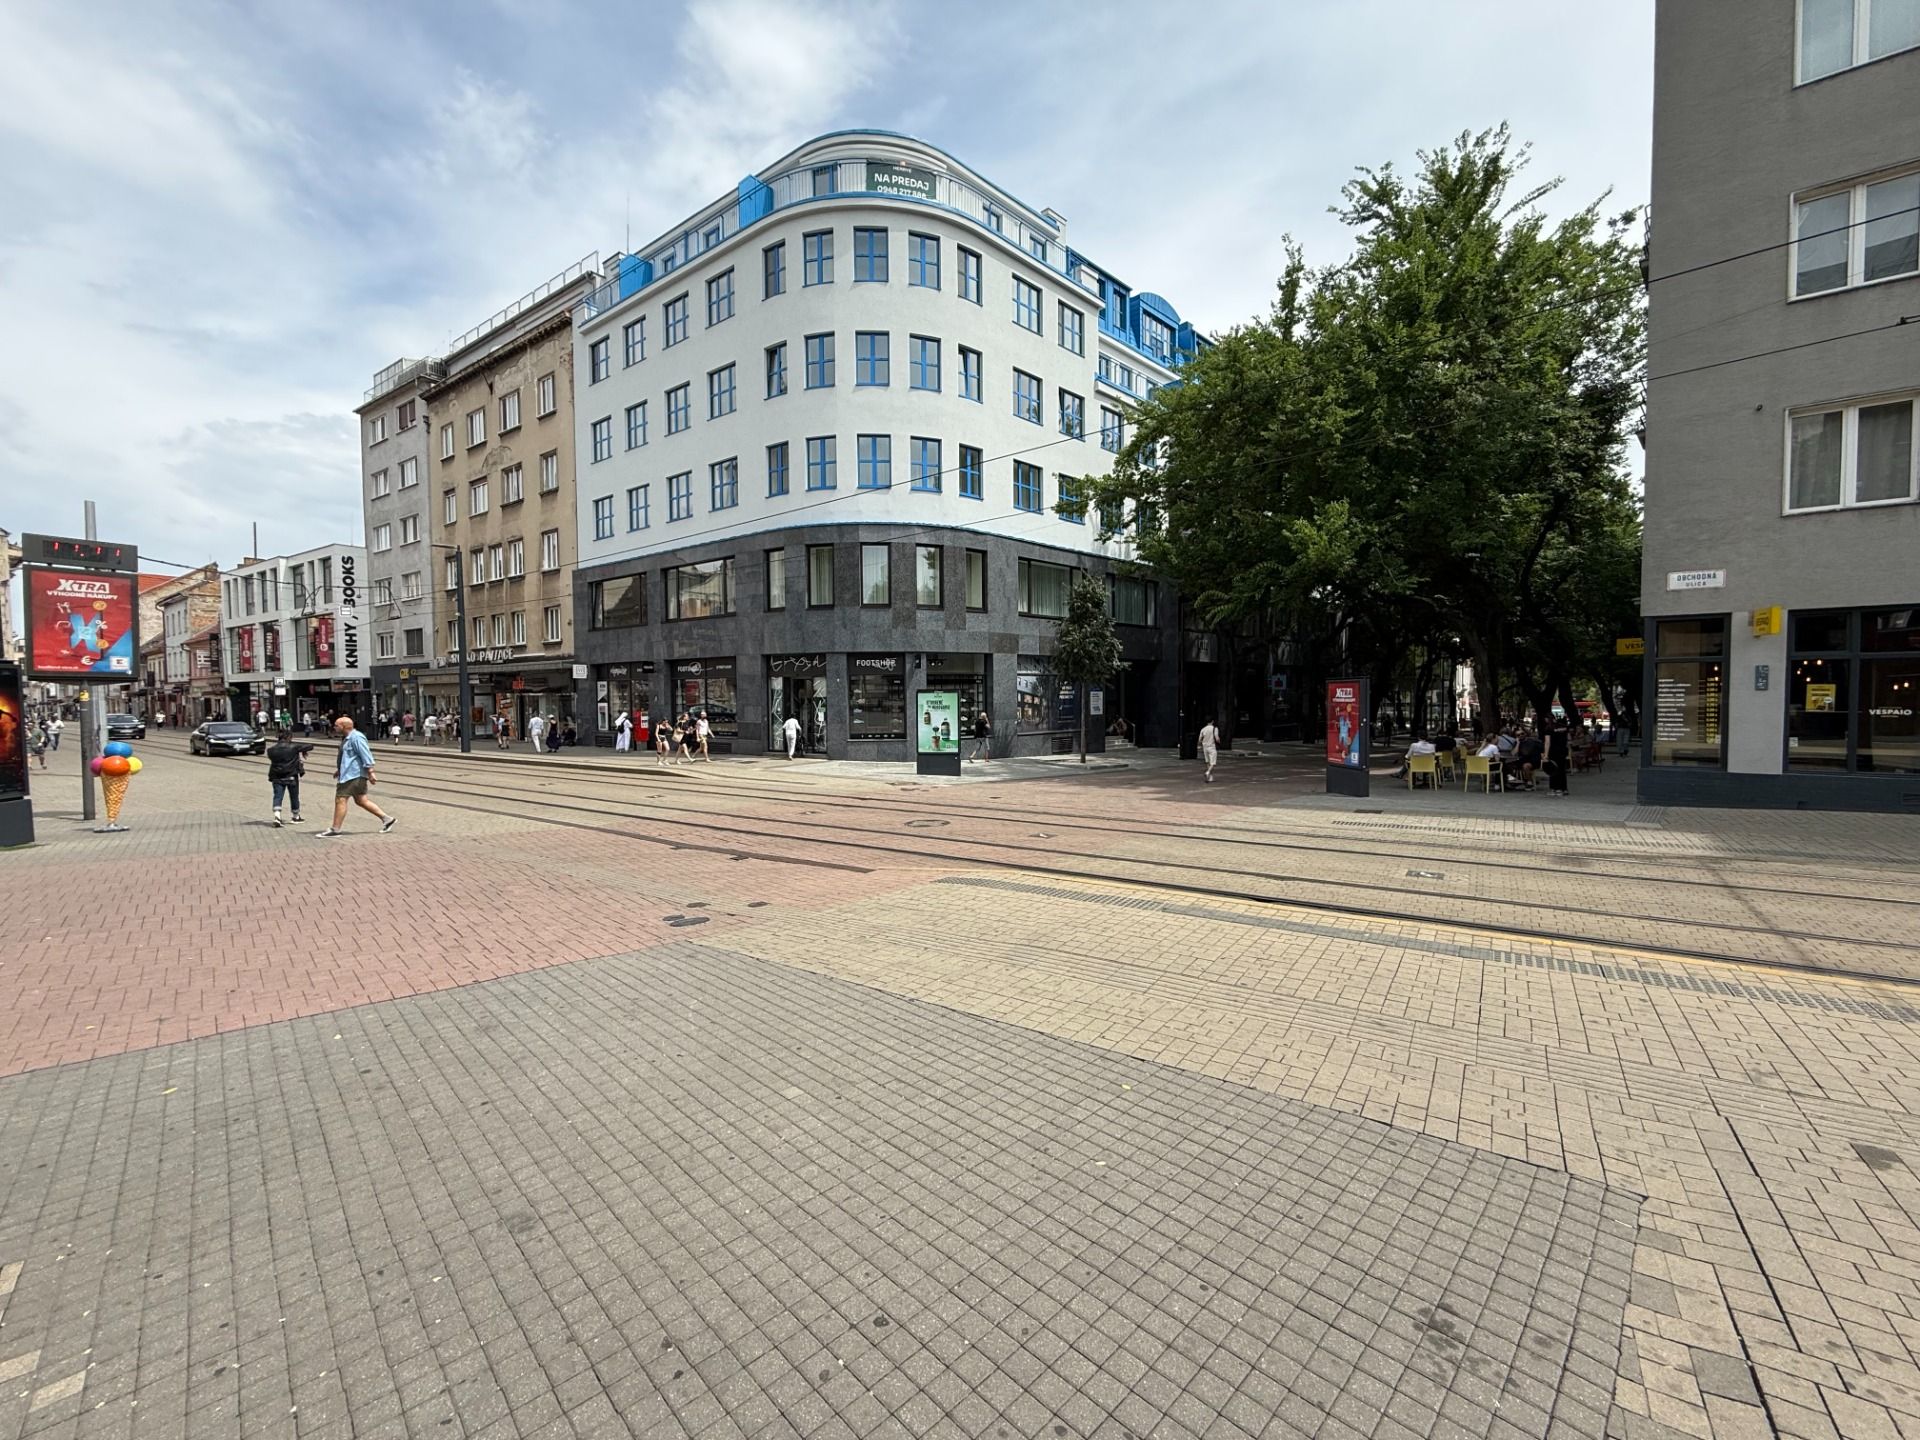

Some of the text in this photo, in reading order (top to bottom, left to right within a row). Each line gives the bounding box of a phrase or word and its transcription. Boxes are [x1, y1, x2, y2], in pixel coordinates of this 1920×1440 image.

[874, 173, 929, 191] NA PREDAJ
[57, 579, 109, 594] XTRA
[341, 555, 356, 608] BOOKS
[344, 622, 358, 669] KNIHY
[1868, 708, 1913, 716] VESPAIO
